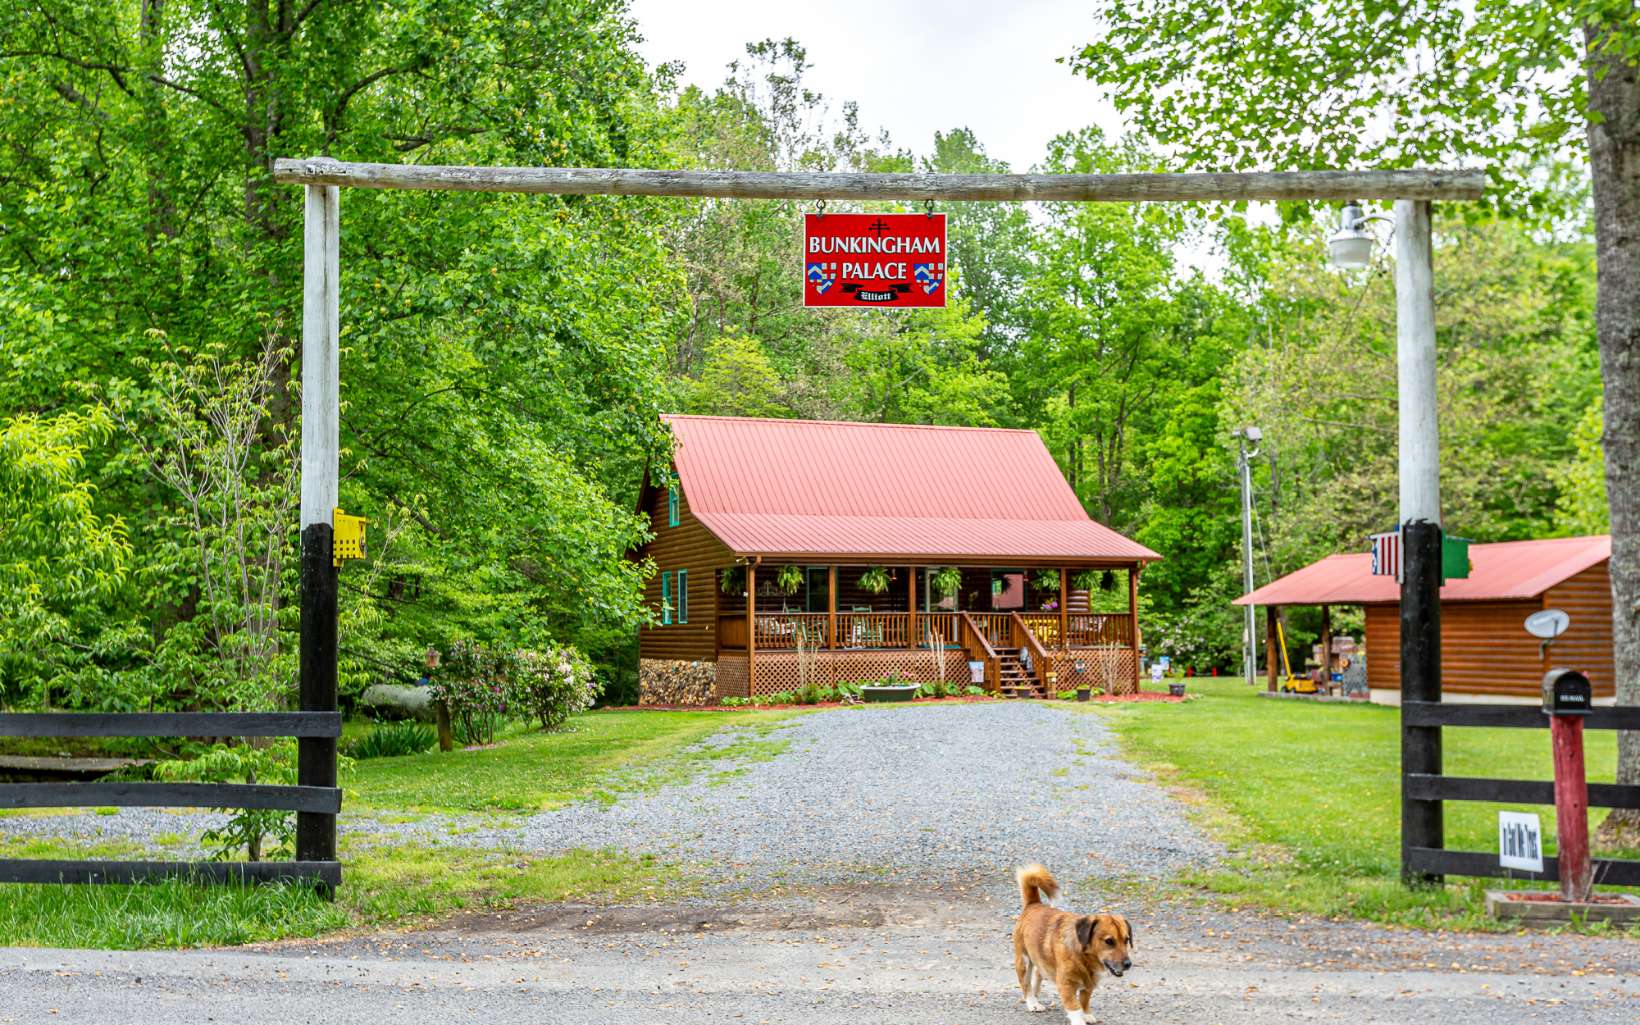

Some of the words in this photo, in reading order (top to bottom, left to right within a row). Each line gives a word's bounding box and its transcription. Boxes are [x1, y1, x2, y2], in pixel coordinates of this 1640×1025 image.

[809, 236, 940, 254] BUNKINGHAM
[841, 262, 907, 279] PALACE
[860, 291, 892, 301] Elliott
